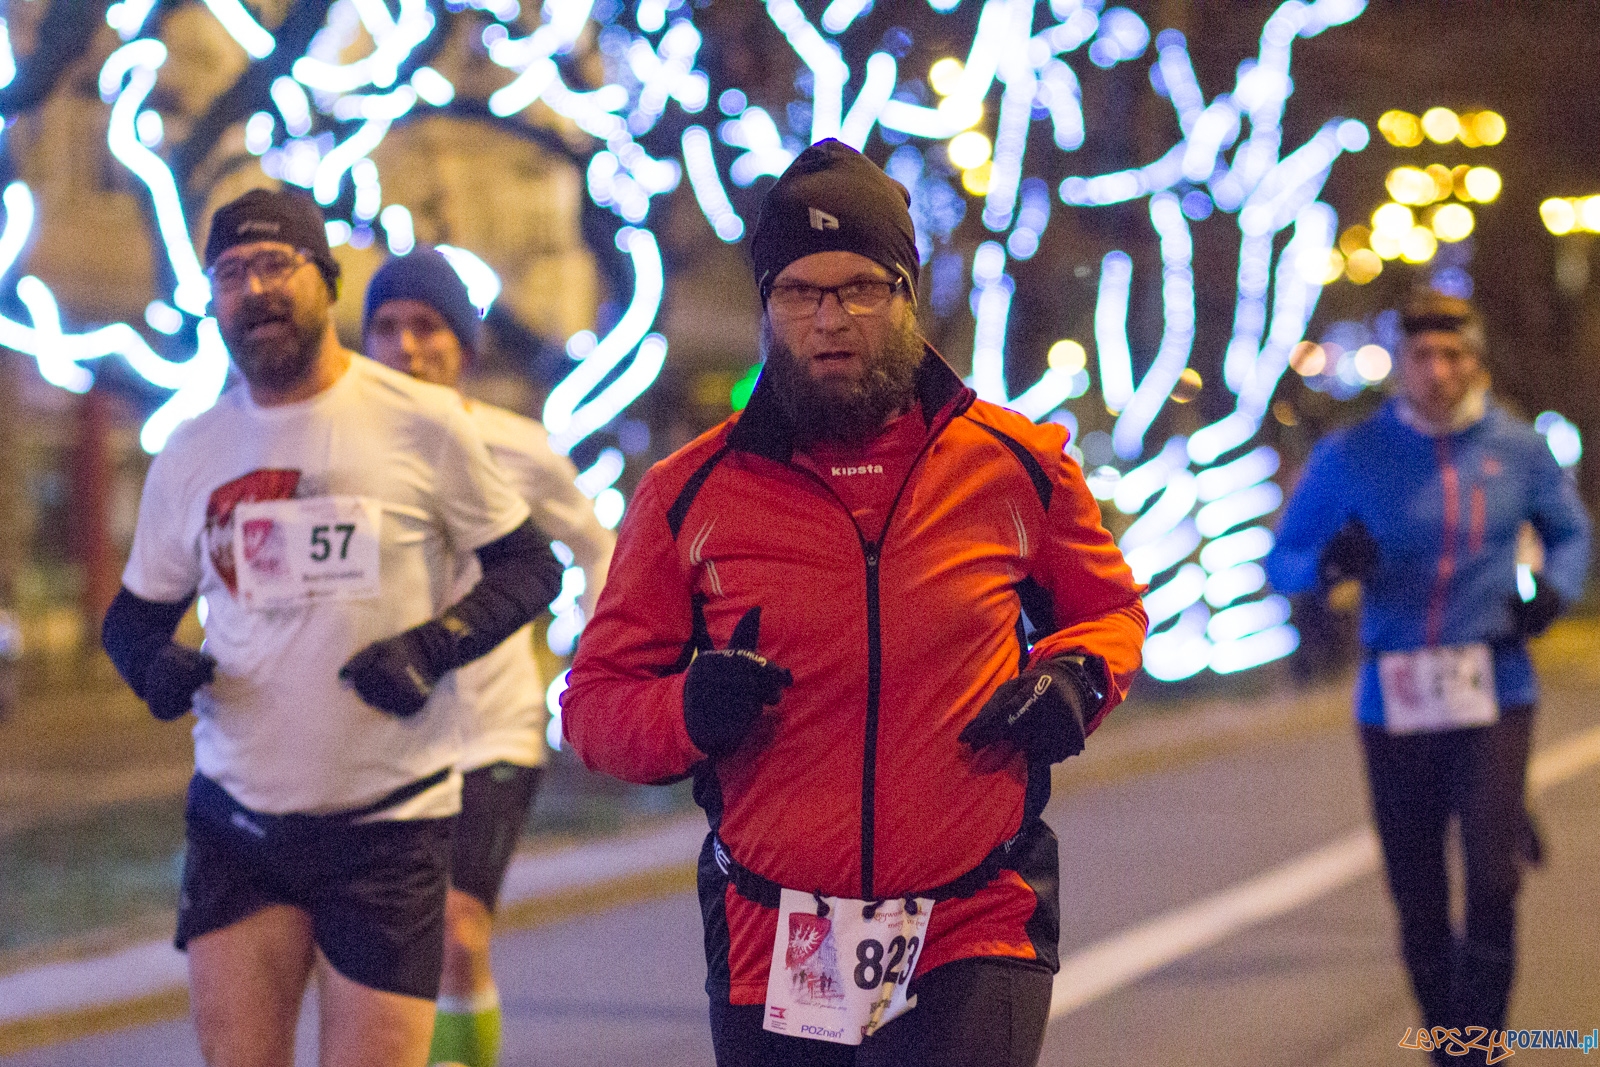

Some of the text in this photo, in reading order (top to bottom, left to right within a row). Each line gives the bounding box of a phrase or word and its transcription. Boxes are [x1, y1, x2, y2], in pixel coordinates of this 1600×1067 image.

[831, 464, 883, 476] kipsta
[311, 523, 356, 562] 57
[854, 935, 920, 990] 823
